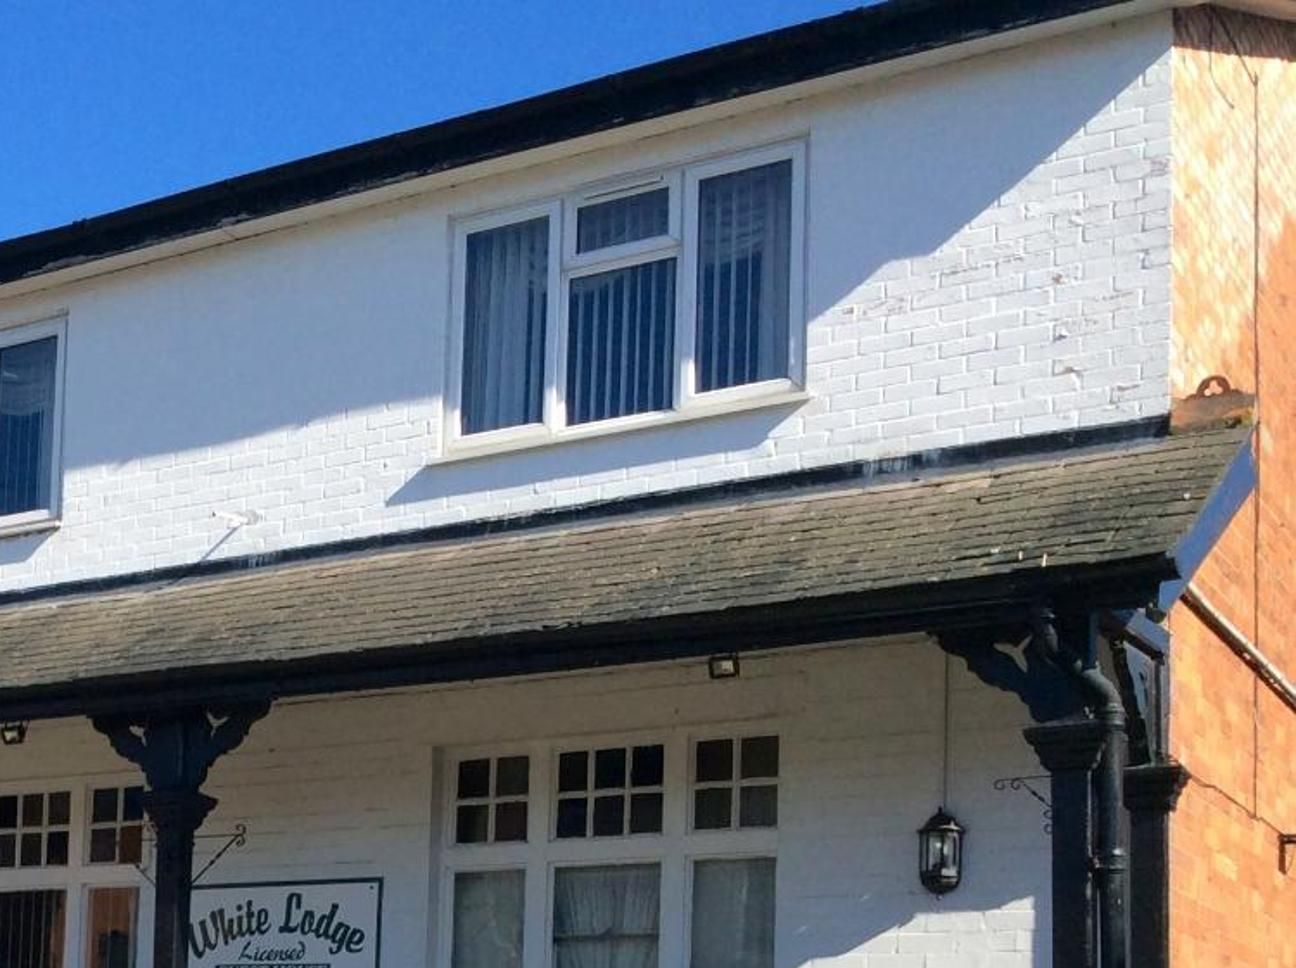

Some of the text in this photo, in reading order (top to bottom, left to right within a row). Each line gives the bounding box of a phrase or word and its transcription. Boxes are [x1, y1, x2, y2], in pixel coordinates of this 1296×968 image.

[188, 892, 365, 959] White Lodge
[238, 940, 306, 961] Licensed
